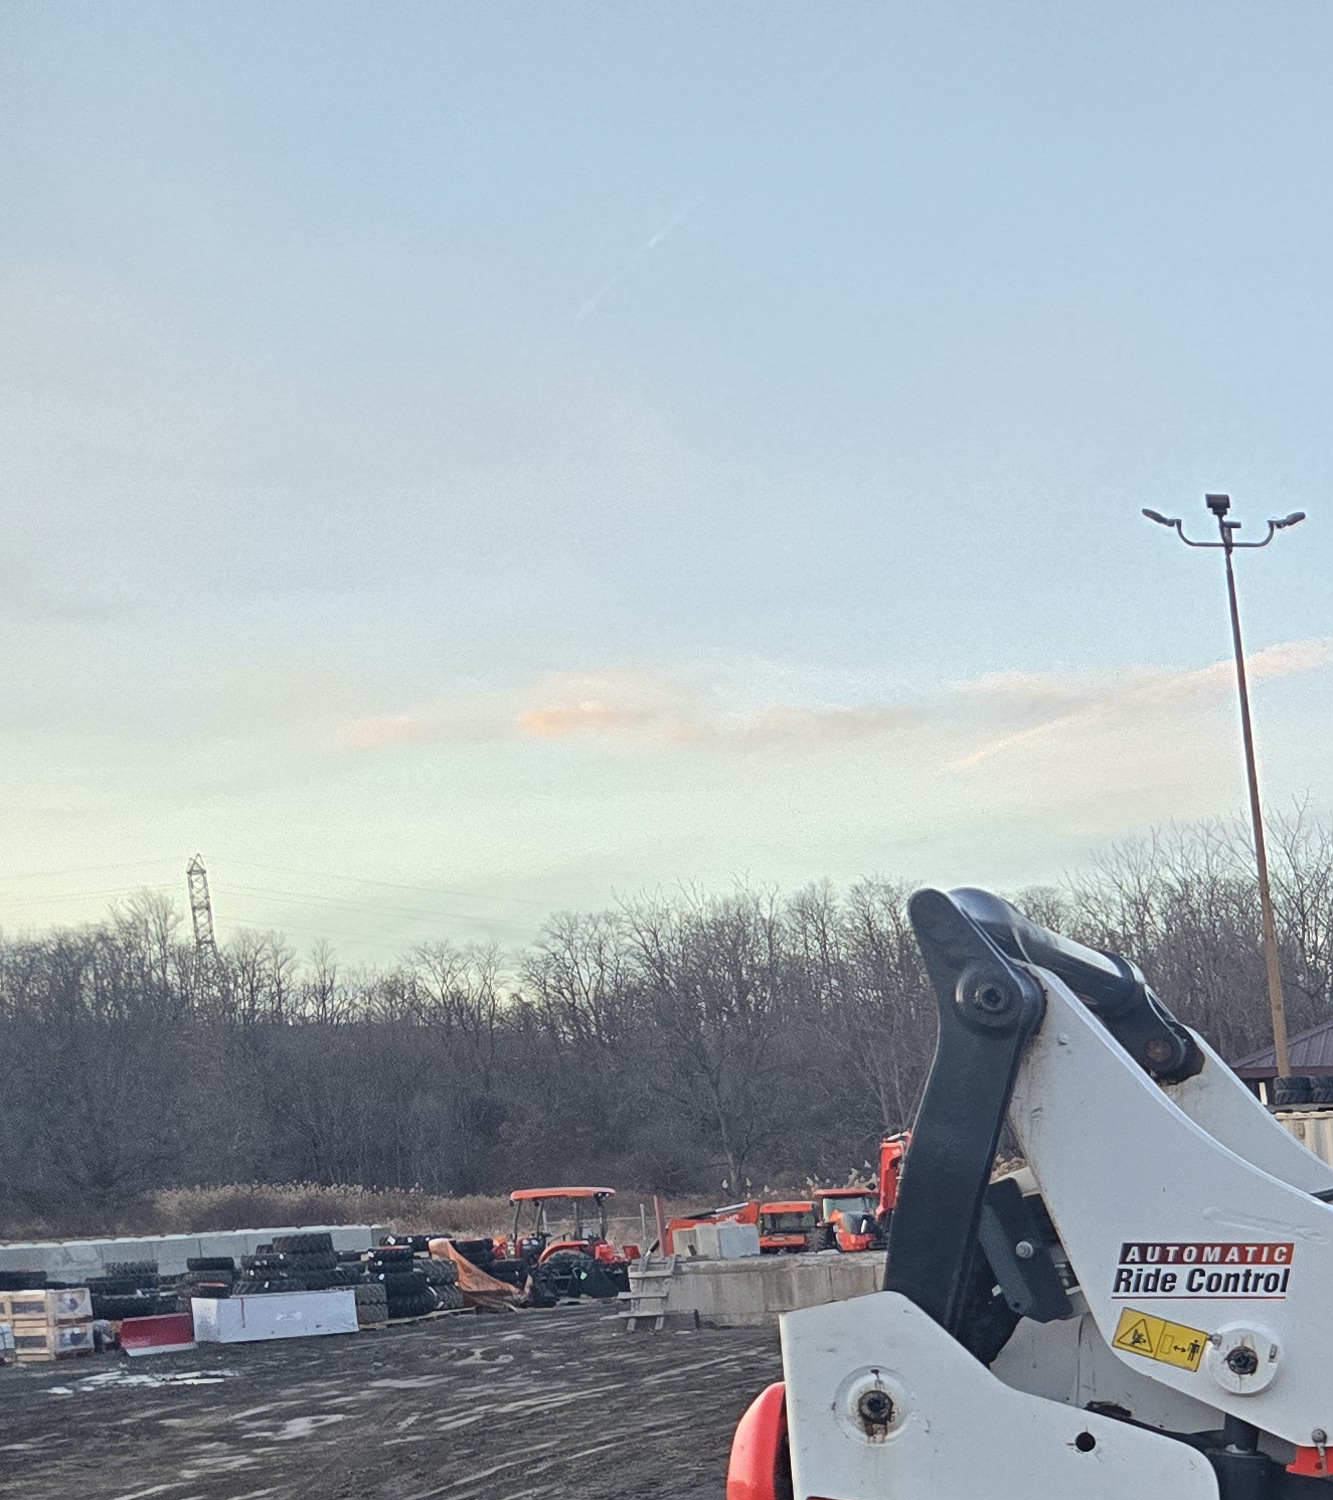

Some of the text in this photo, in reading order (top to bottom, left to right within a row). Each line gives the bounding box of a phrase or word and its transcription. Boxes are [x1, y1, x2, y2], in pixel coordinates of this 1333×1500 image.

[1125, 1246, 1288, 1262] AUTOMATIC
[1112, 1268, 1290, 1293] Ride Control
